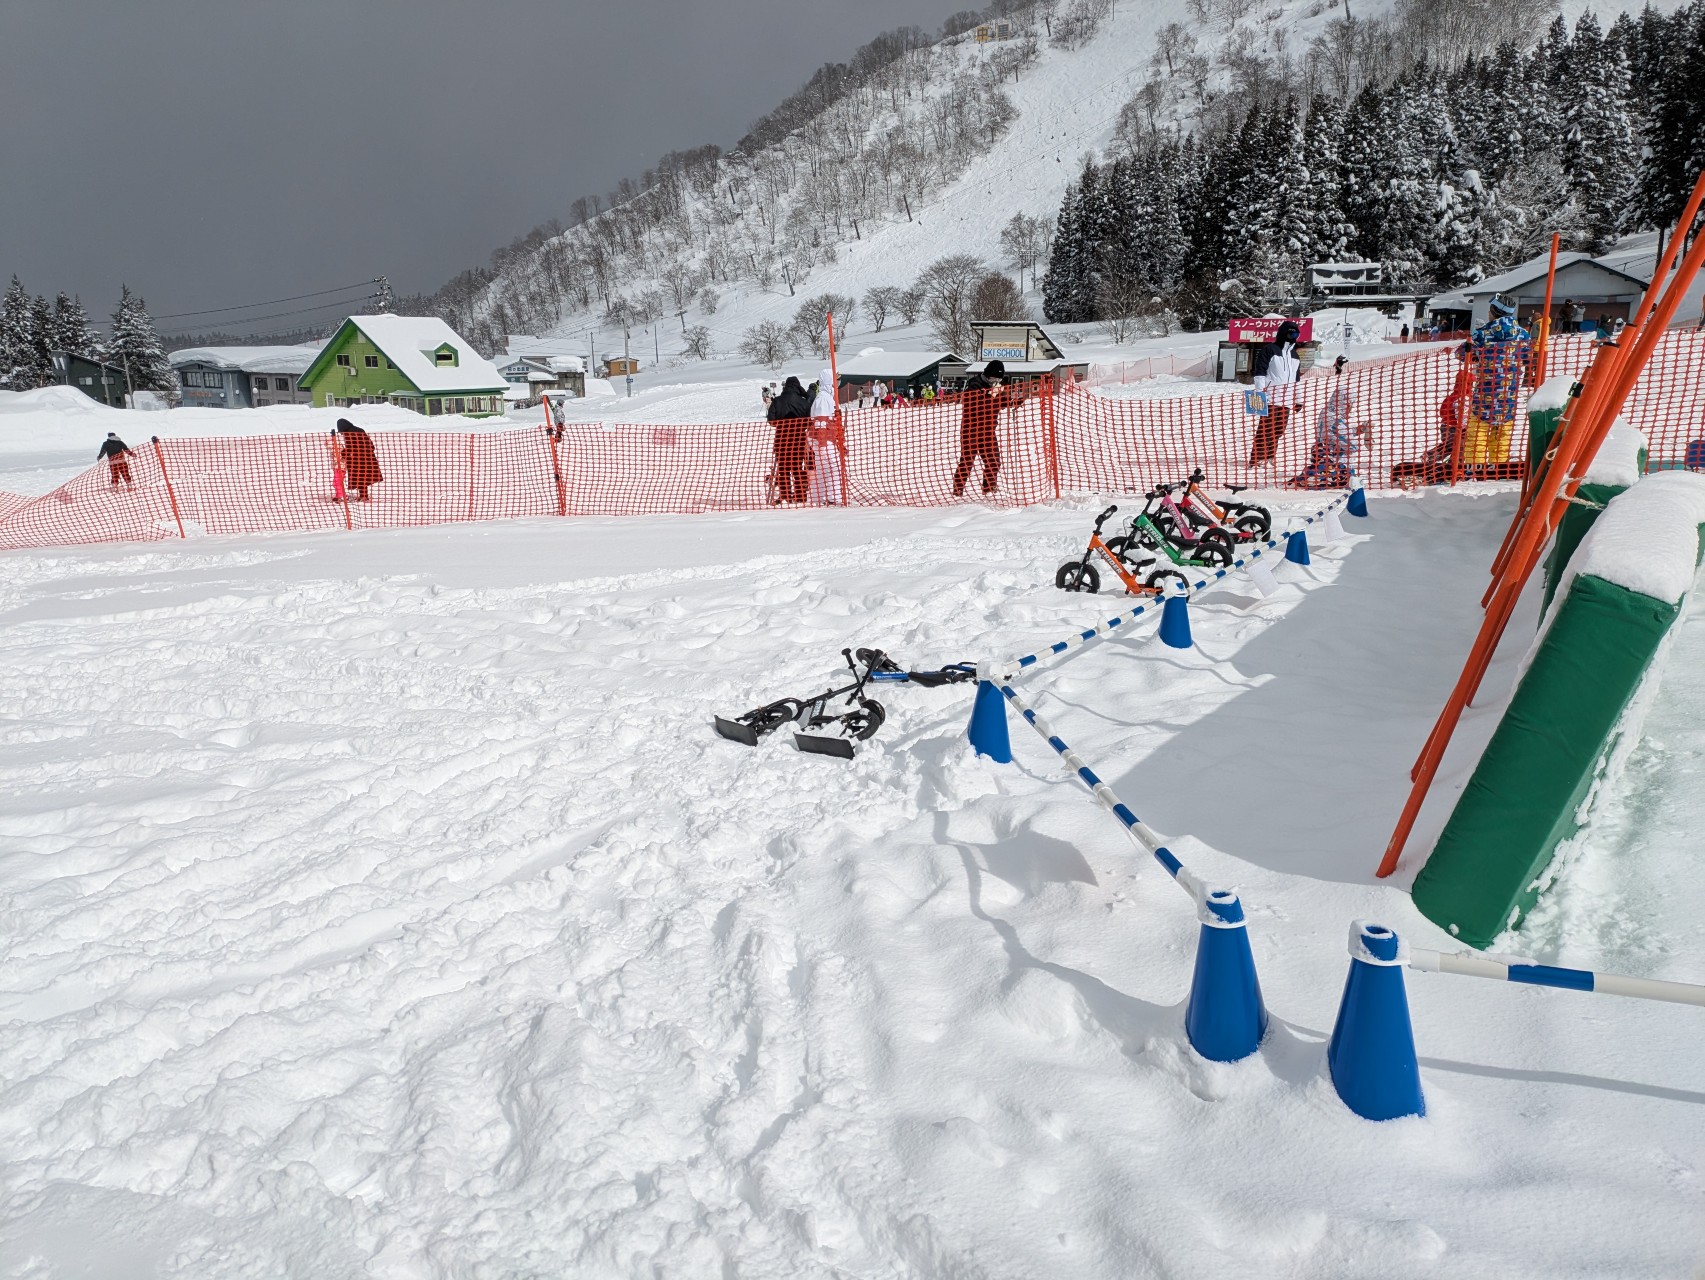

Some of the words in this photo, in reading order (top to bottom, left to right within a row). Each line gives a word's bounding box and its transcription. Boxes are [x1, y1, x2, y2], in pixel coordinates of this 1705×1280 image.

[983, 349, 995, 357] SKI
[996, 349, 1025, 358] SCHOOL
[1194, 490, 1216, 511] STRIDER
[1166, 503, 1185, 529] STRIDER
[1144, 523, 1168, 549] STRIDER
[1097, 546, 1123, 574] STRIDER
